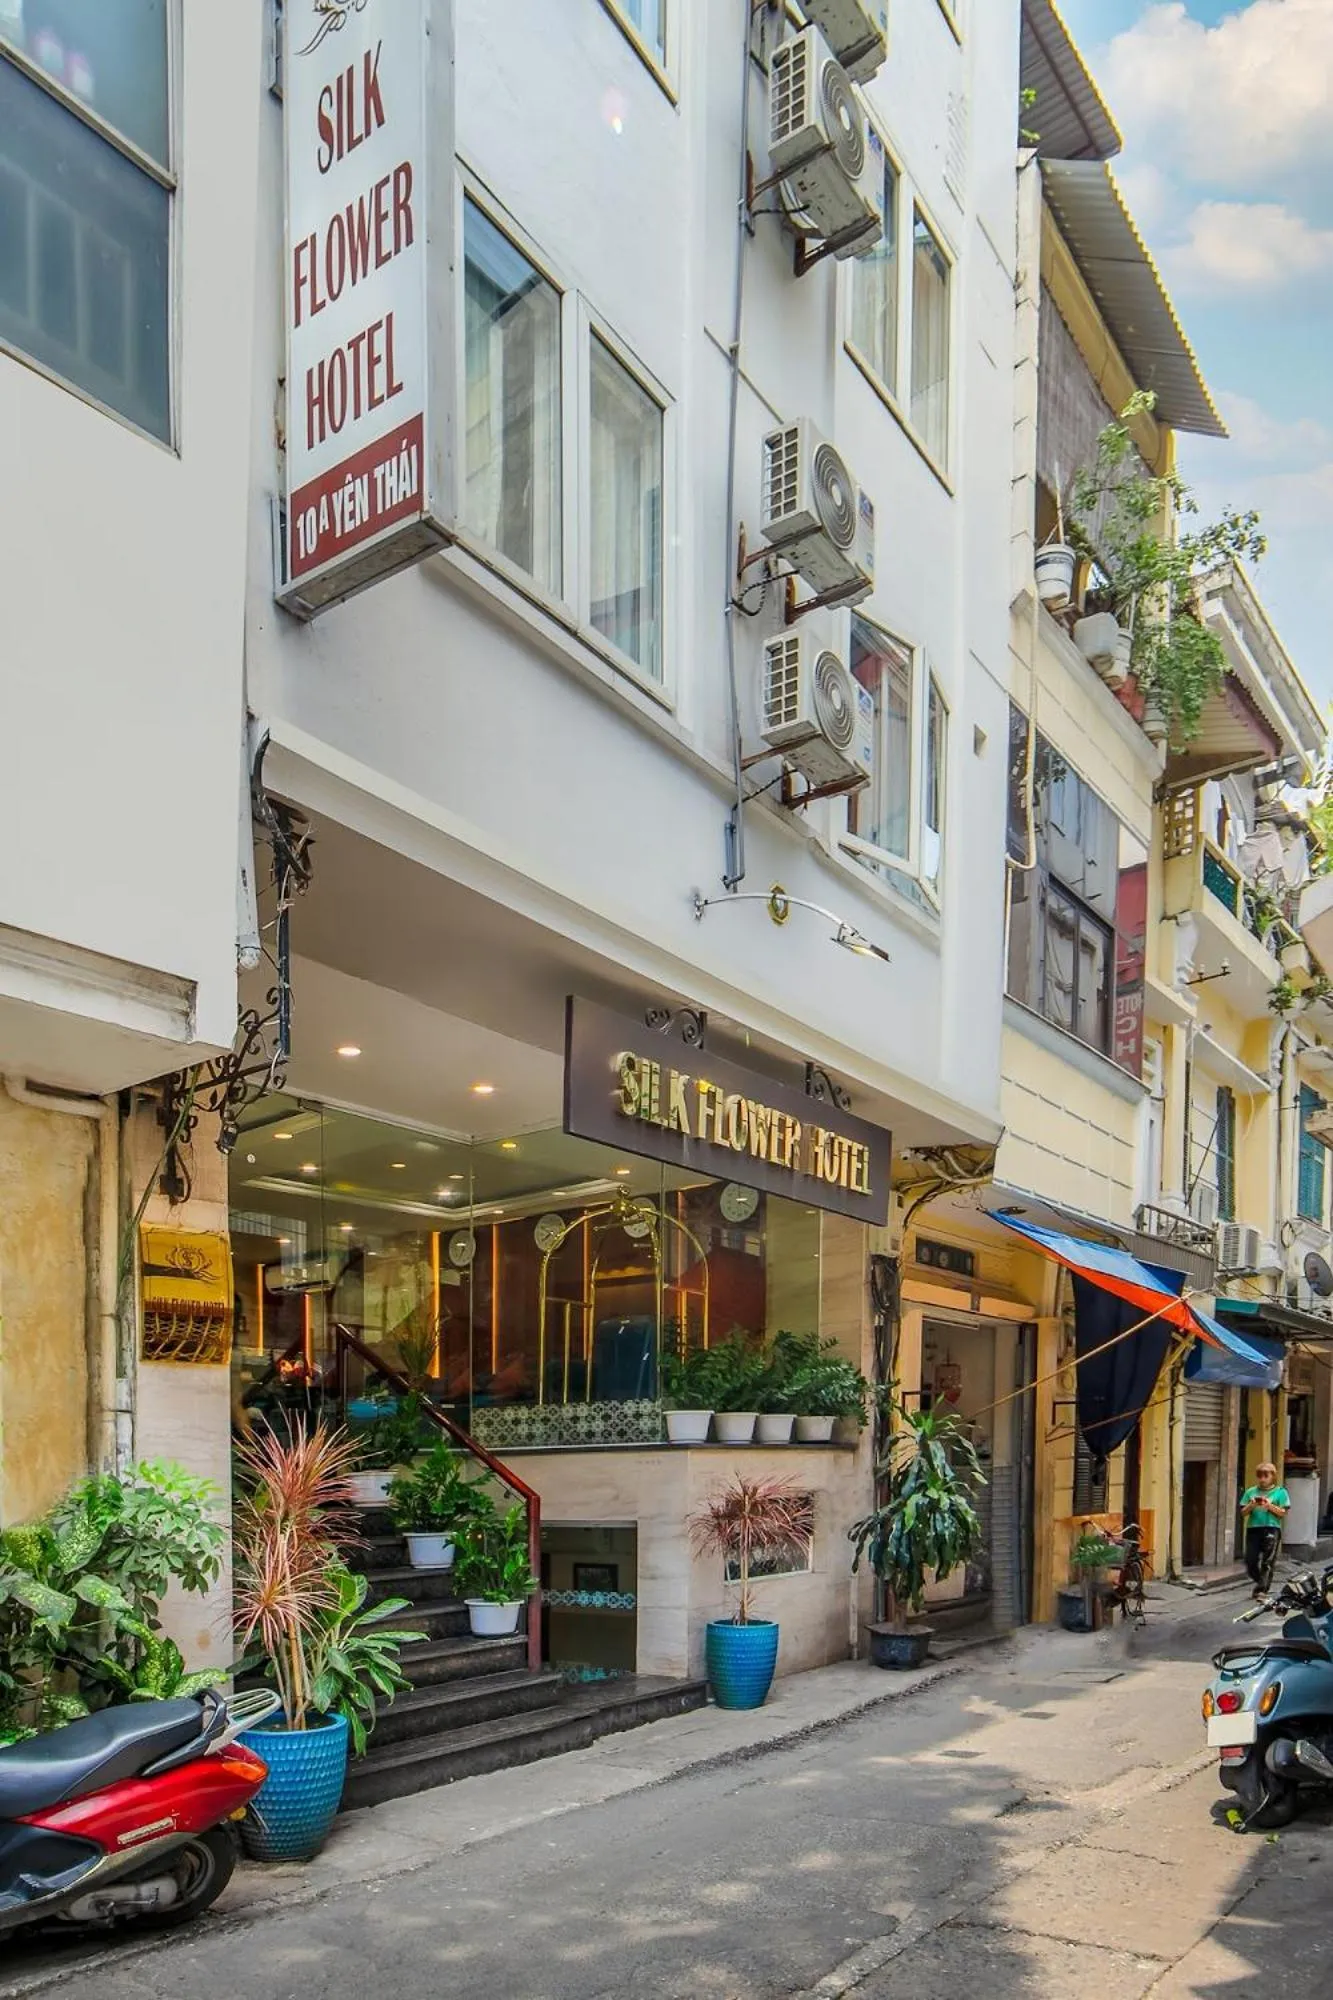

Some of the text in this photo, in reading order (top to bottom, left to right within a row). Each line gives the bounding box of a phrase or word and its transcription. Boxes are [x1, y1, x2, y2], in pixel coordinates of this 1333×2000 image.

[317, 40, 385, 174] SILK
[294, 161, 414, 328] FLOWER
[306, 312, 404, 451] HOTEL
[333, 473, 370, 538] YÊN
[374, 438, 418, 515] THÁI
[615, 1052, 873, 1195] SILK FLOWER HOTEL
